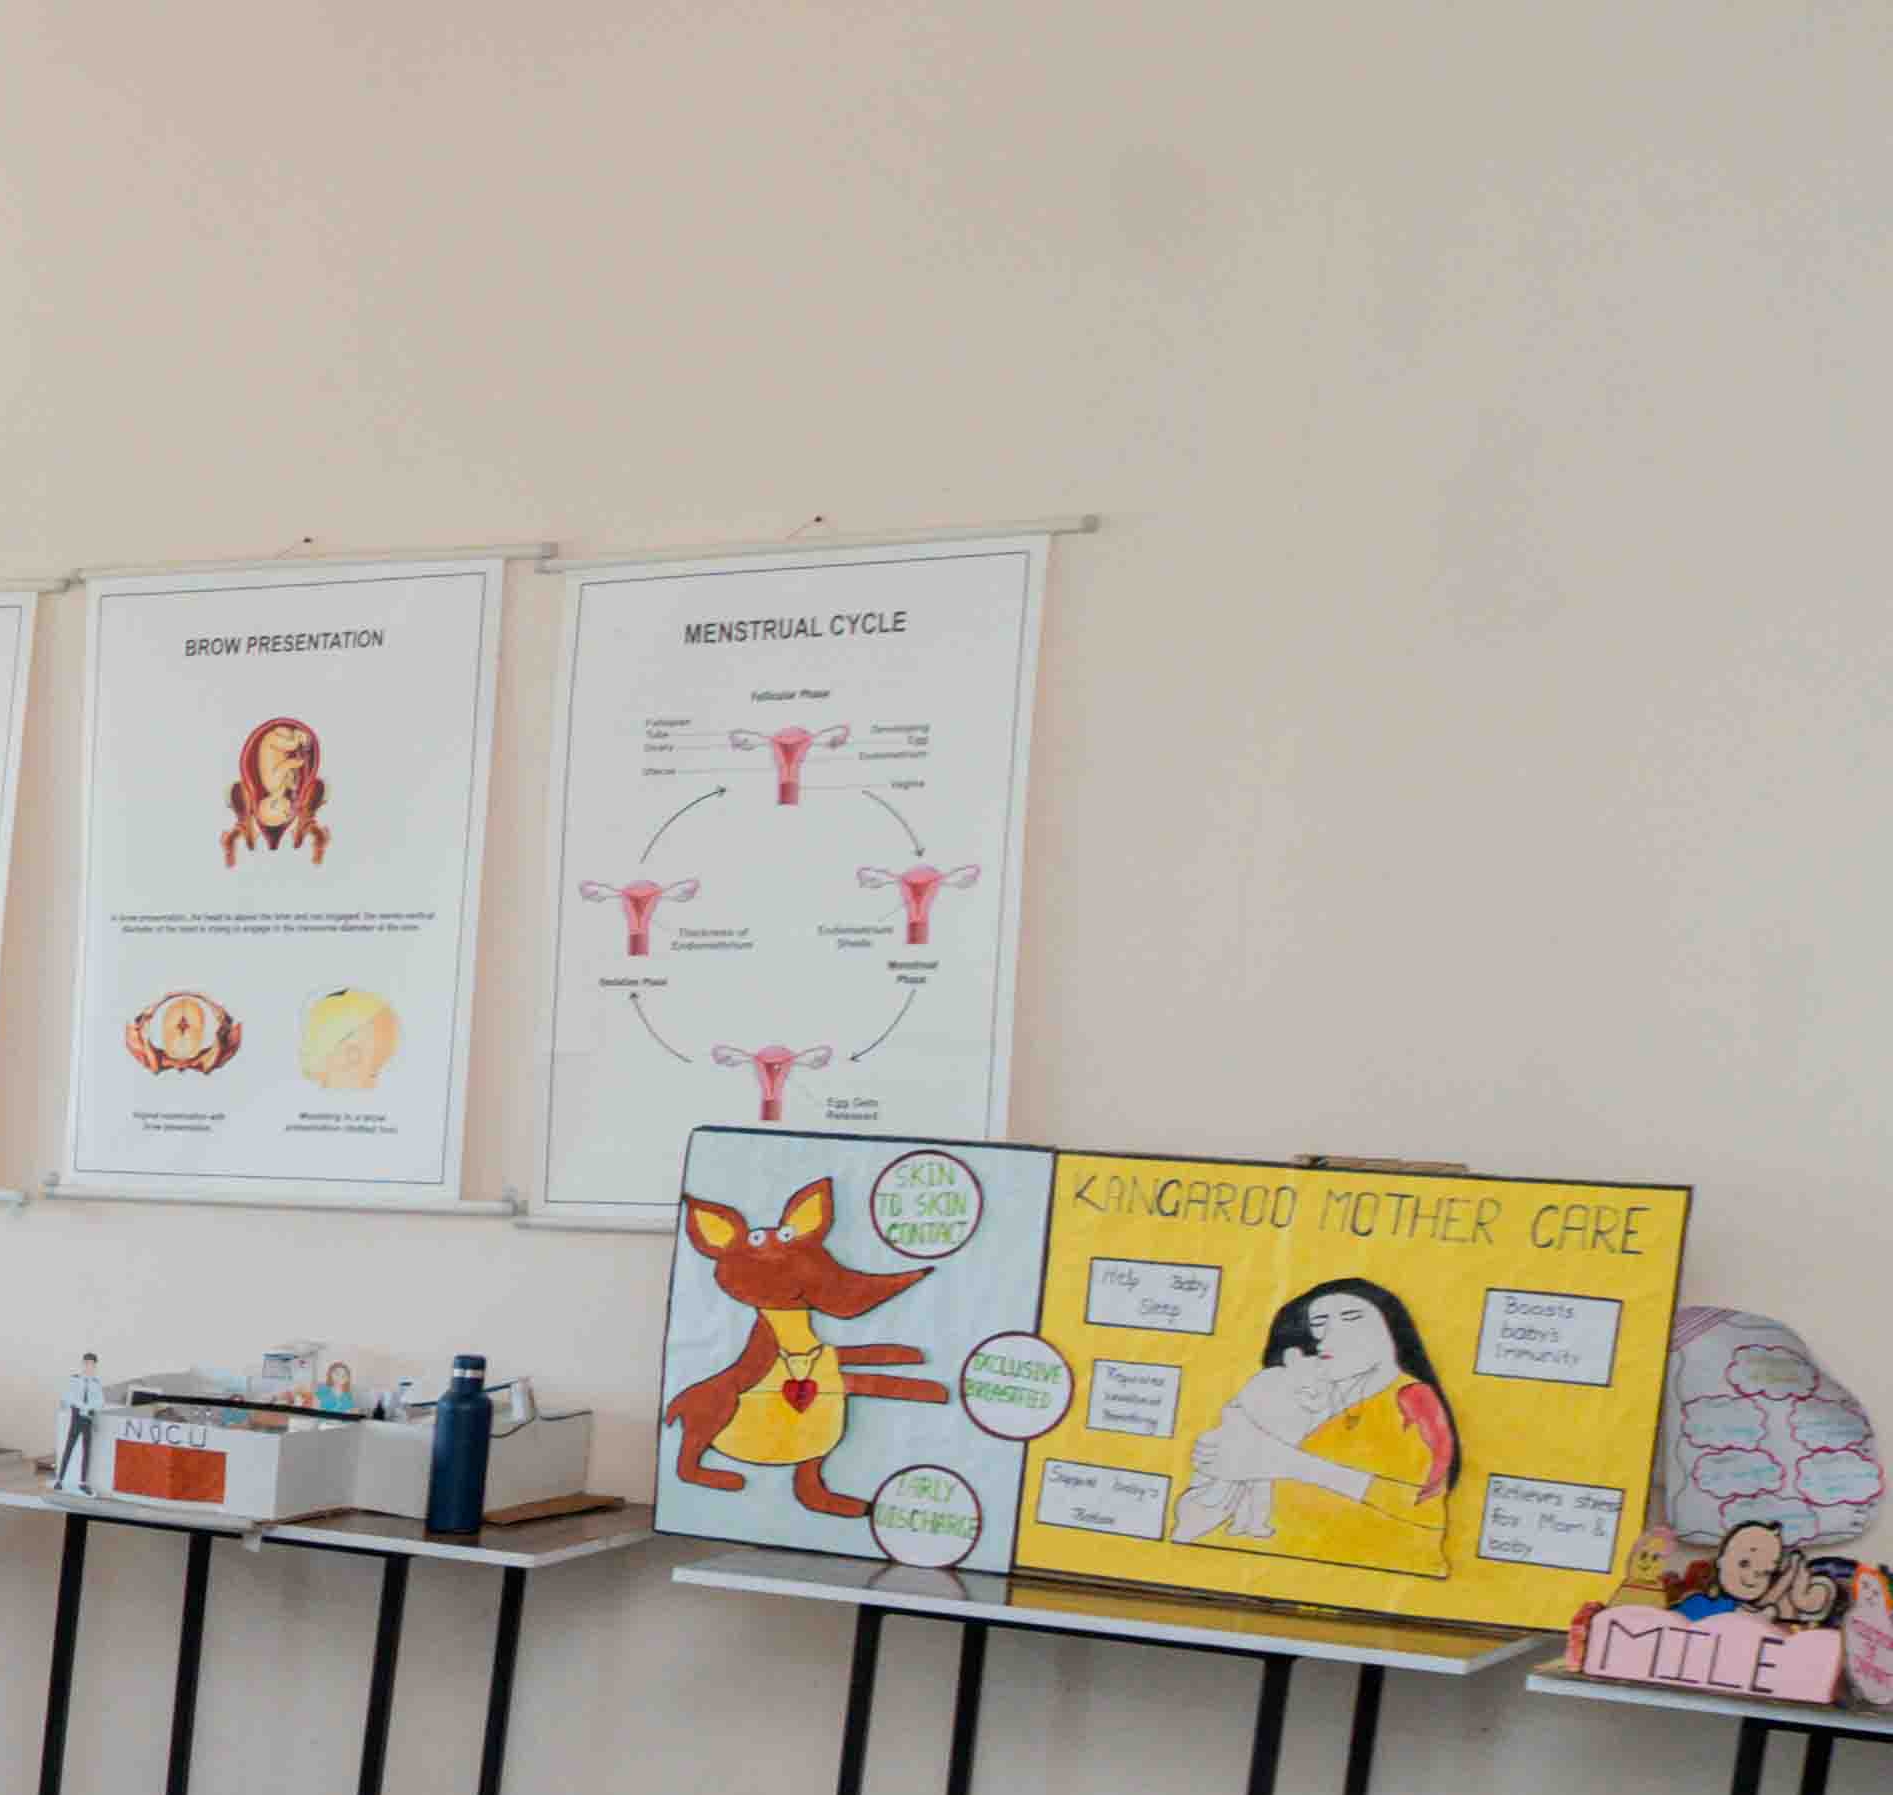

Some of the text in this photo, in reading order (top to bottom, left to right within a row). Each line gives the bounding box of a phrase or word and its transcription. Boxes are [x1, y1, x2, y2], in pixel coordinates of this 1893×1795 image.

[184, 630, 385, 657] BROW PRESENTATION
[684, 611, 908, 644] MENSTRUAL CYCLE
[1073, 1172, 1652, 1256] KANGAROO MOTHER CARE
[1599, 1620, 1785, 1693] MILE
